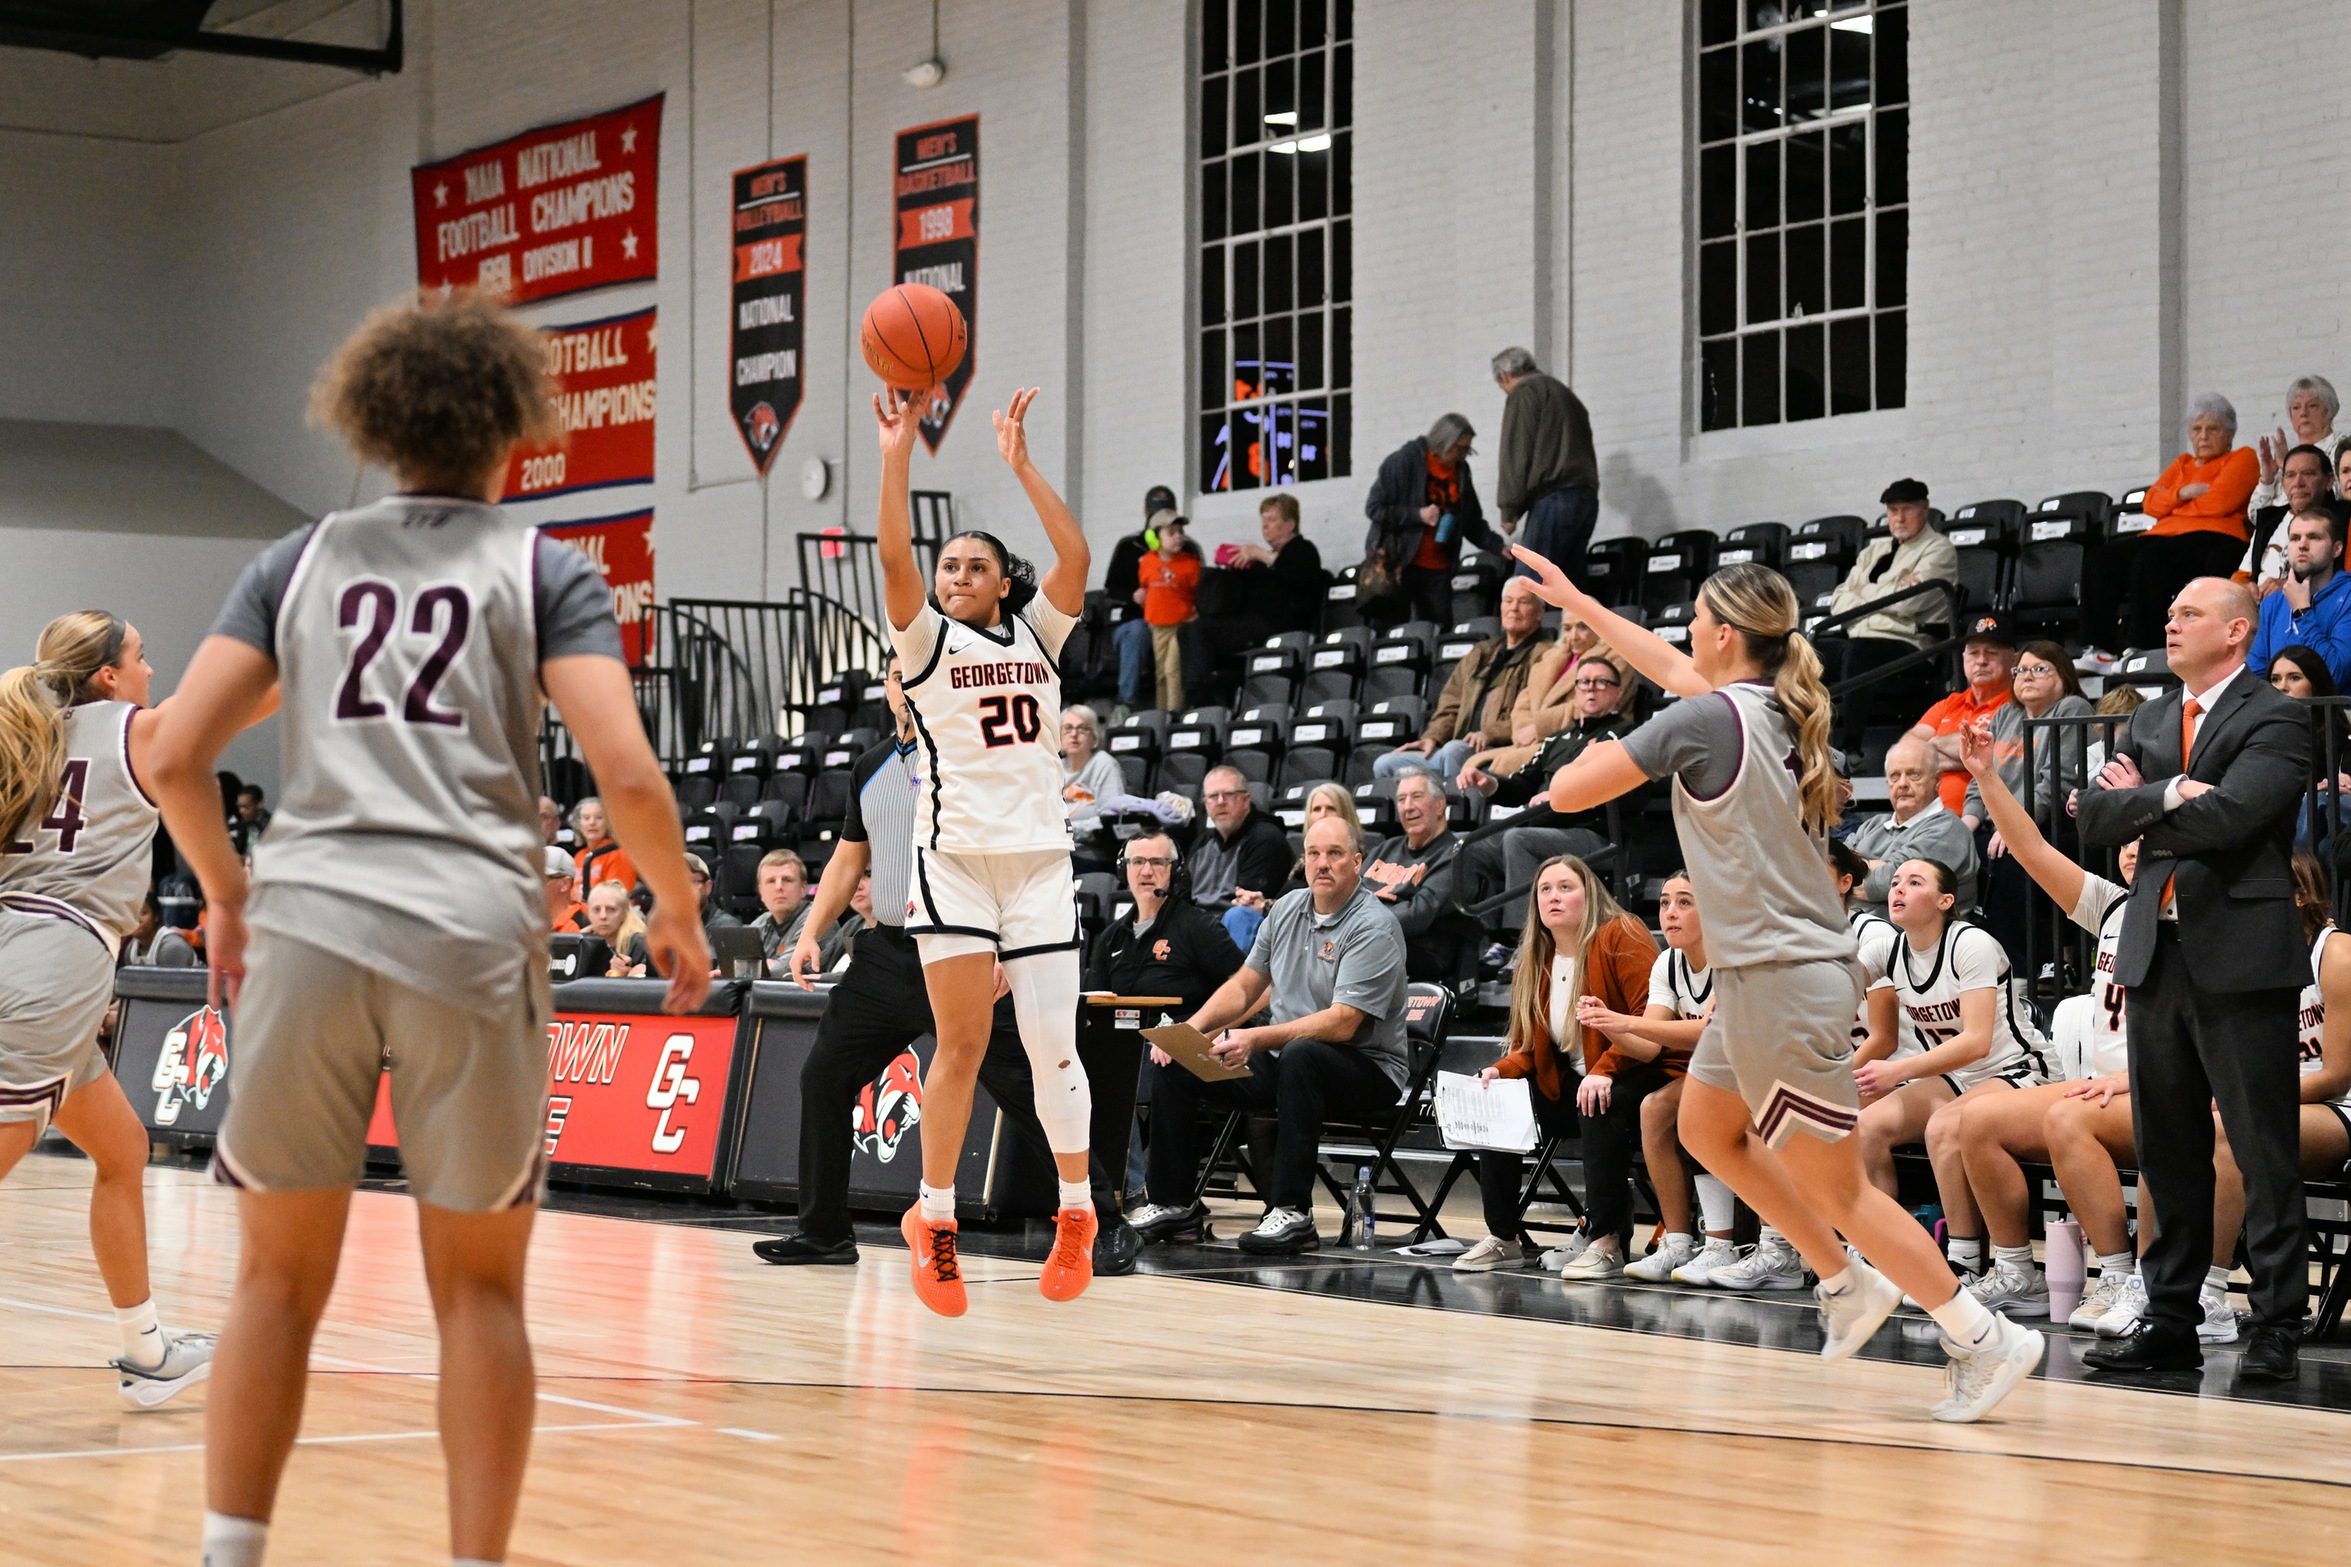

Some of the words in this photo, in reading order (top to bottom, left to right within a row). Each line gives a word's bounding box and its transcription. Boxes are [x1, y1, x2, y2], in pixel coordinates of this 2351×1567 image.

[516, 130, 601, 190] NATIONAL
[437, 202, 521, 263] FOOTBALL
[531, 170, 635, 234] CHAMPIONS
[522, 238, 580, 283] DIVISION
[750, 241, 783, 275] 2024
[739, 293, 794, 331] NATIONAL
[736, 349, 796, 387] CHAMPION
[549, 379, 656, 432] HAMPIONS
[521, 452, 566, 491] 2000
[330, 572, 473, 733] 22
[950, 662, 1050, 690] GEORGETOWN
[978, 692, 1042, 750] 20
